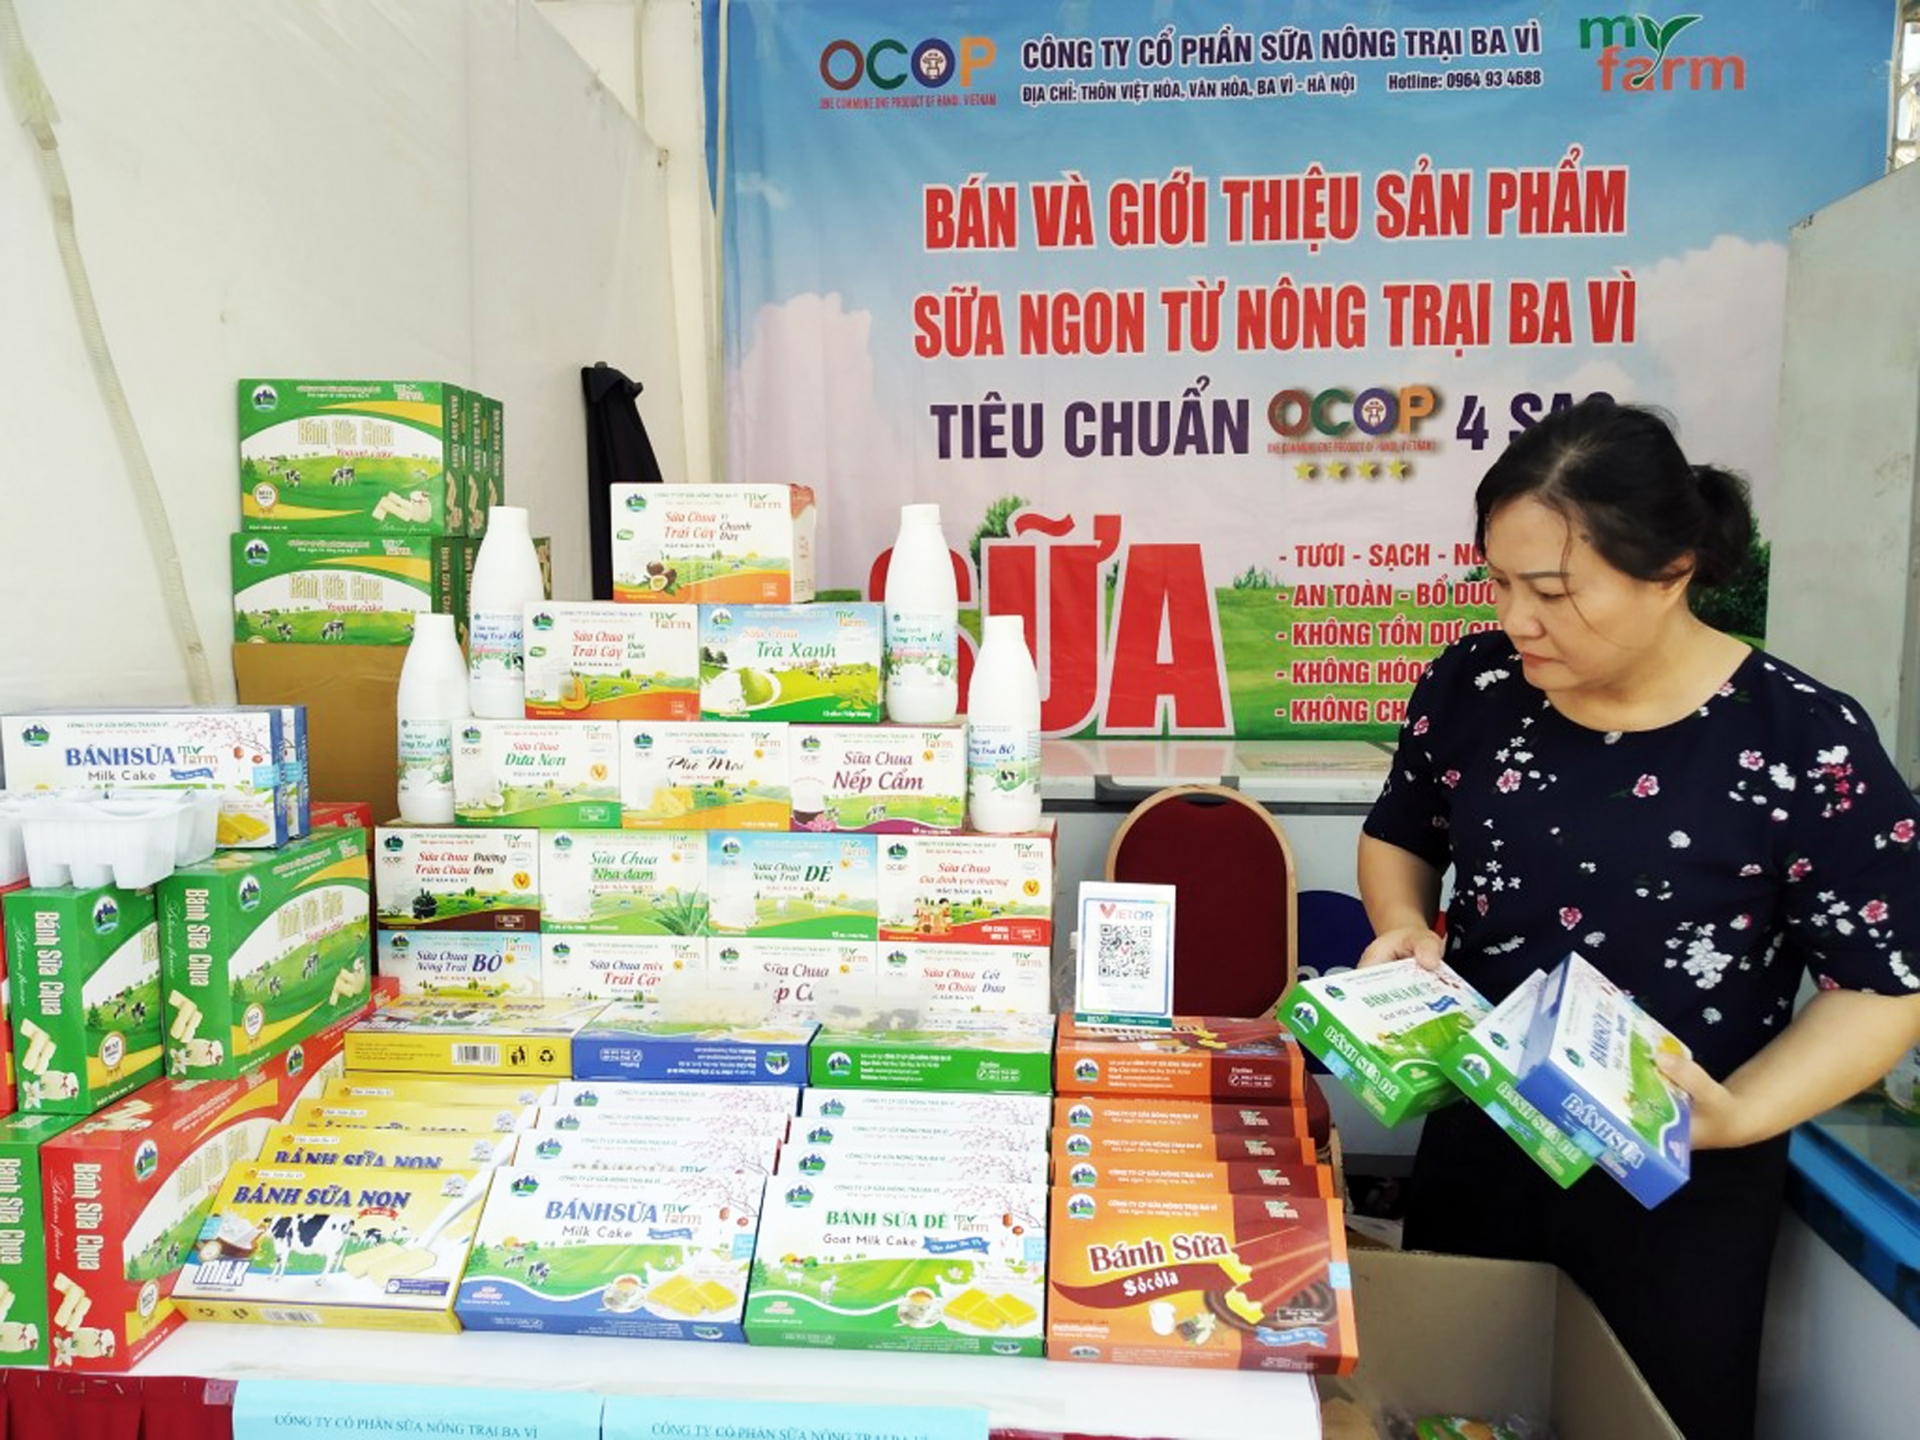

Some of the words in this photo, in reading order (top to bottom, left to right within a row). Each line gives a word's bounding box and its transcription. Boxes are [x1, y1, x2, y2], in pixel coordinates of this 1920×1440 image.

[1022, 35, 1092, 69] CÔNG
[1101, 39, 1129, 66] TY
[1138, 24, 1171, 66] CỔ
[1181, 24, 1252, 65] PHẦN
[1261, 25, 1313, 61] SỮA
[1321, 26, 1396, 58] NÔNG
[1405, 28, 1461, 62] TRẠI
[1471, 29, 1506, 55] BA
[1513, 20, 1541, 54] VÌ
[819, 36, 997, 91] OCOP
[1597, 45, 1746, 92] farm
[1022, 85, 1046, 104] ĐỊA
[1081, 82, 1116, 101] THÔN
[1119, 80, 1149, 101] VIỆT
[1257, 79, 1275, 97] BA
[1278, 76, 1294, 95] VÌ
[1307, 75, 1326, 95] HÀ
[1330, 73, 1355, 96] NỘI
[1389, 72, 1443, 91] Hotline:
[1447, 72, 1483, 89] 0964
[1485, 71, 1505, 88] 93
[1507, 70, 1541, 87] 4688
[925, 176, 1016, 250] BÁN
[1034, 172, 1093, 247] VÀ
[1110, 169, 1207, 245] GIỚI
[1224, 165, 1359, 252] THIỆU
[1376, 157, 1471, 238] SẢN
[1488, 146, 1627, 235] PHẨM
[914, 285, 1003, 356] SỮA
[1020, 289, 1144, 354] NGON
[1162, 280, 1225, 351] TỪ
[1237, 276, 1366, 349] NÔNG
[1384, 282, 1491, 356] TRẠI
[1509, 281, 1573, 344] BA
[1589, 270, 1636, 344] VÌ
[930, 391, 1044, 459] TIÊU
[1064, 375, 1250, 456] CHUẨN
[1267, 384, 1437, 438] OCOP
[1455, 395, 1489, 450] 4
[1295, 544, 1345, 567] TƯƠI
[1369, 543, 1430, 572] SẠCH
[1293, 584, 1325, 606] AN
[1333, 579, 1392, 606] TOÀN
[1416, 574, 1446, 606] BỔ
[1293, 617, 1370, 645] KHÔNG
[1379, 615, 1422, 645] TỒN
[756, 641, 785, 658] Trà
[789, 642, 837, 659] Xanh
[1292, 658, 1369, 684] KHÔNG
[1377, 656, 1432, 684] HÓO
[1291, 697, 1368, 722] KHÔNG
[537, 753, 566, 766] Non
[875, 751, 913, 766] Chua
[87, 770, 116, 781] Milk
[121, 770, 156, 781] Cake
[832, 771, 873, 793] Nếp
[877, 767, 924, 790] Cẩm
[620, 851, 658, 865] Chua
[593, 867, 622, 880] Nha
[792, 963, 830, 977] Chua
[232, 1182, 302, 1205] BÁNH
[305, 1184, 354, 1208] SỮA
[357, 1189, 412, 1210] NON
[561, 1224, 591, 1237] Milk
[597, 1225, 633, 1239] Cake
[826, 1209, 877, 1229] BÁNH
[823, 1233, 852, 1245] Goat
[856, 1234, 881, 1246] Milk
[886, 1235, 918, 1247] Cake
[1090, 1240, 1165, 1272] Bánh
[1174, 1232, 1229, 1260] Sữa
[192, 1259, 250, 1287] MILK
